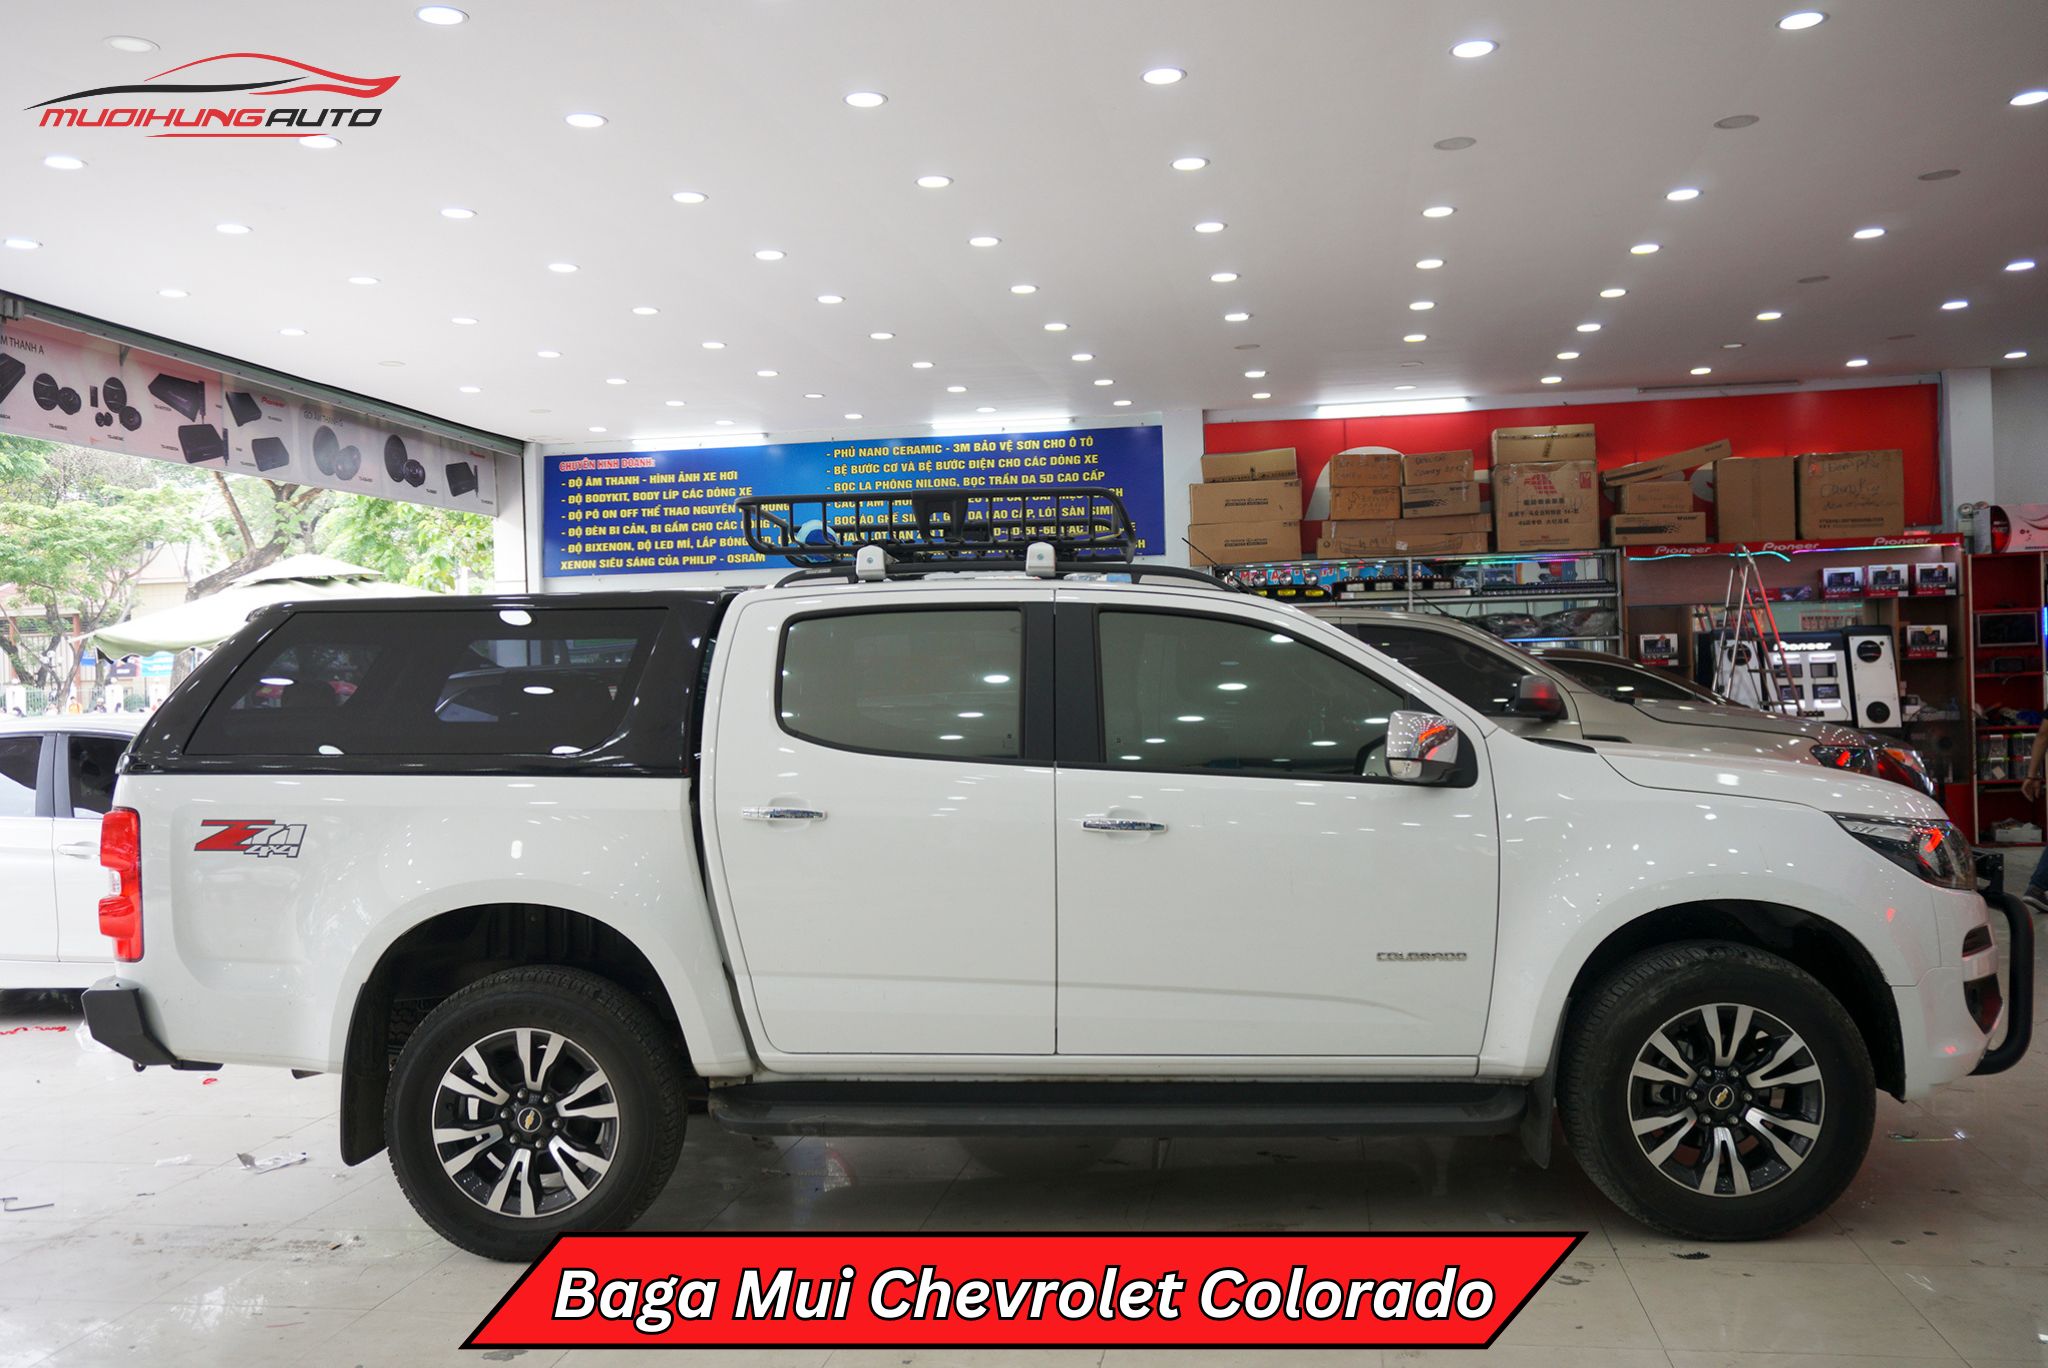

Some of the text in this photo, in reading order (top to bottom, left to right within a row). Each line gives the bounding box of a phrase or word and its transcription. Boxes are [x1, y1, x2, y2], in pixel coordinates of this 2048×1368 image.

[9, 337, 37, 353] THANH
[859, 447, 889, 457] NANO
[892, 444, 943, 456] CERAMIC
[953, 443, 970, 453] 3M
[973, 439, 997, 452] BẢO
[1043, 438, 1066, 449] CHO
[1069, 436, 1077, 448] Ô
[1080, 435, 1094, 447] TÔ
[998, 458, 1021, 468] CHO
[1024, 456, 1047, 467] CÁC
[1084, 454, 1099, 464] XE
[585, 476, 602, 487] ÂM
[605, 475, 640, 485] THANH
[703, 472, 717, 482] XE
[859, 480, 874, 491] LA
[875, 479, 913, 490] PHÔNG
[1021, 474, 1037, 484] DA
[1040, 474, 1054, 484] 5D
[1057, 472, 1080, 483] CAO
[585, 492, 630, 503] BODYKIT,
[632, 491, 659, 501] BODY
[682, 488, 704, 499] CÁC
[739, 487, 753, 497] XE
[602, 509, 617, 519] ON
[619, 508, 638, 519] OFF
[663, 506, 690, 516] THAO
[609, 526, 620, 535] BI
[650, 524, 662, 534] BI
[691, 521, 713, 531] CHO
[716, 519, 737, 531] CÁC
[654, 540, 674, 550] LED
[1762, 542, 1820, 551] Pioneer
[1873, 537, 1932, 546] Pioneer
[1655, 545, 1712, 555] Pioneer
[560, 560, 596, 570] XENON
[599, 557, 623, 568] SIÊU
[682, 555, 717, 565] PHILIP
[727, 553, 766, 564] OSRAM
[194, 819, 307, 852] Z71
[1376, 952, 1467, 962] COLORADO
